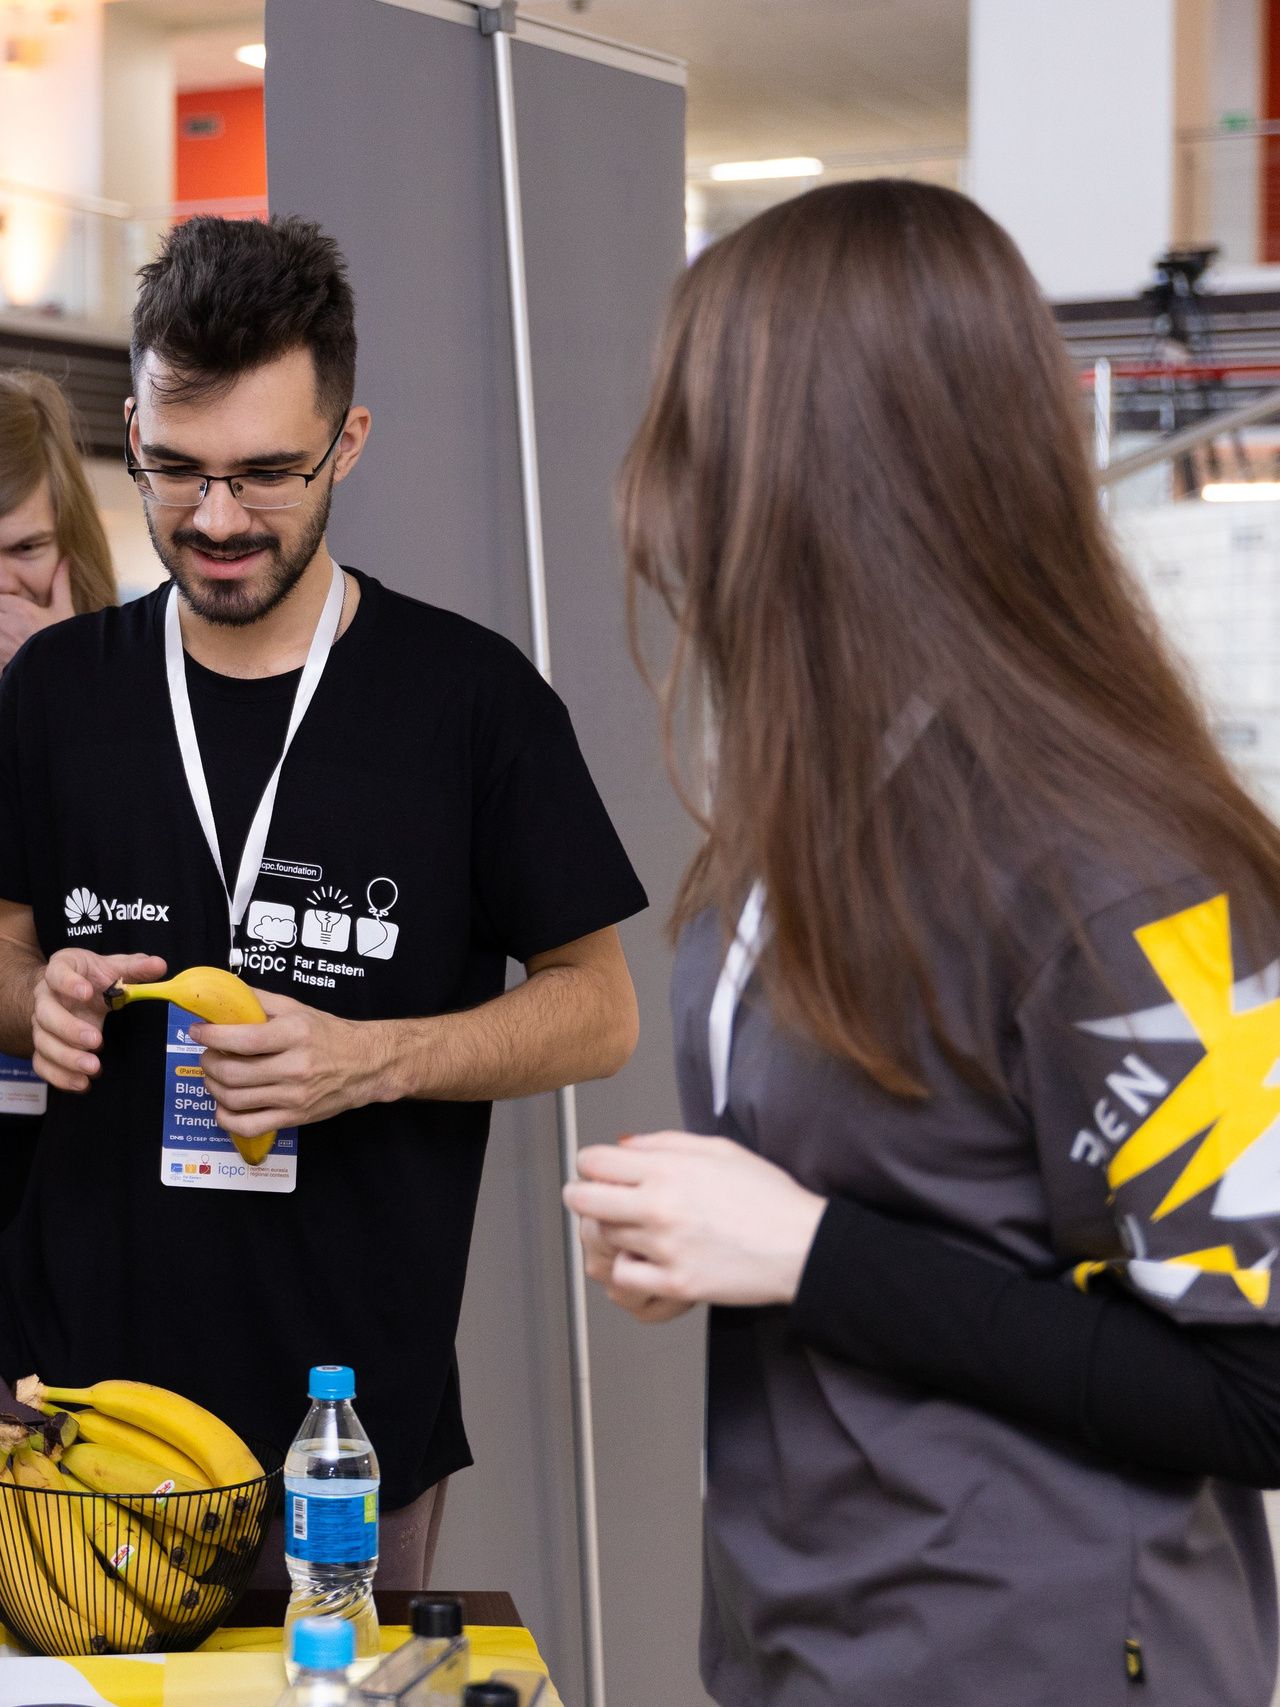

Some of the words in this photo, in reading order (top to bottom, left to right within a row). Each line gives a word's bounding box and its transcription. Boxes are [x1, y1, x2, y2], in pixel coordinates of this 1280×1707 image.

[260, 861, 317, 877] cpc.foundation
[101, 898, 169, 922] Yandex
[67, 924, 103, 937] HUAWE
[243, 949, 287, 974] icpc
[294, 955, 315, 970] Far
[317, 959, 365, 977] Eastern
[292, 970, 336, 988] Russia
[179, 1068, 205, 1076] (Particip
[174, 1098, 218, 1111] SPedU
[174, 1114, 218, 1129] Tranqu
[218, 1162, 246, 1178] icpc
